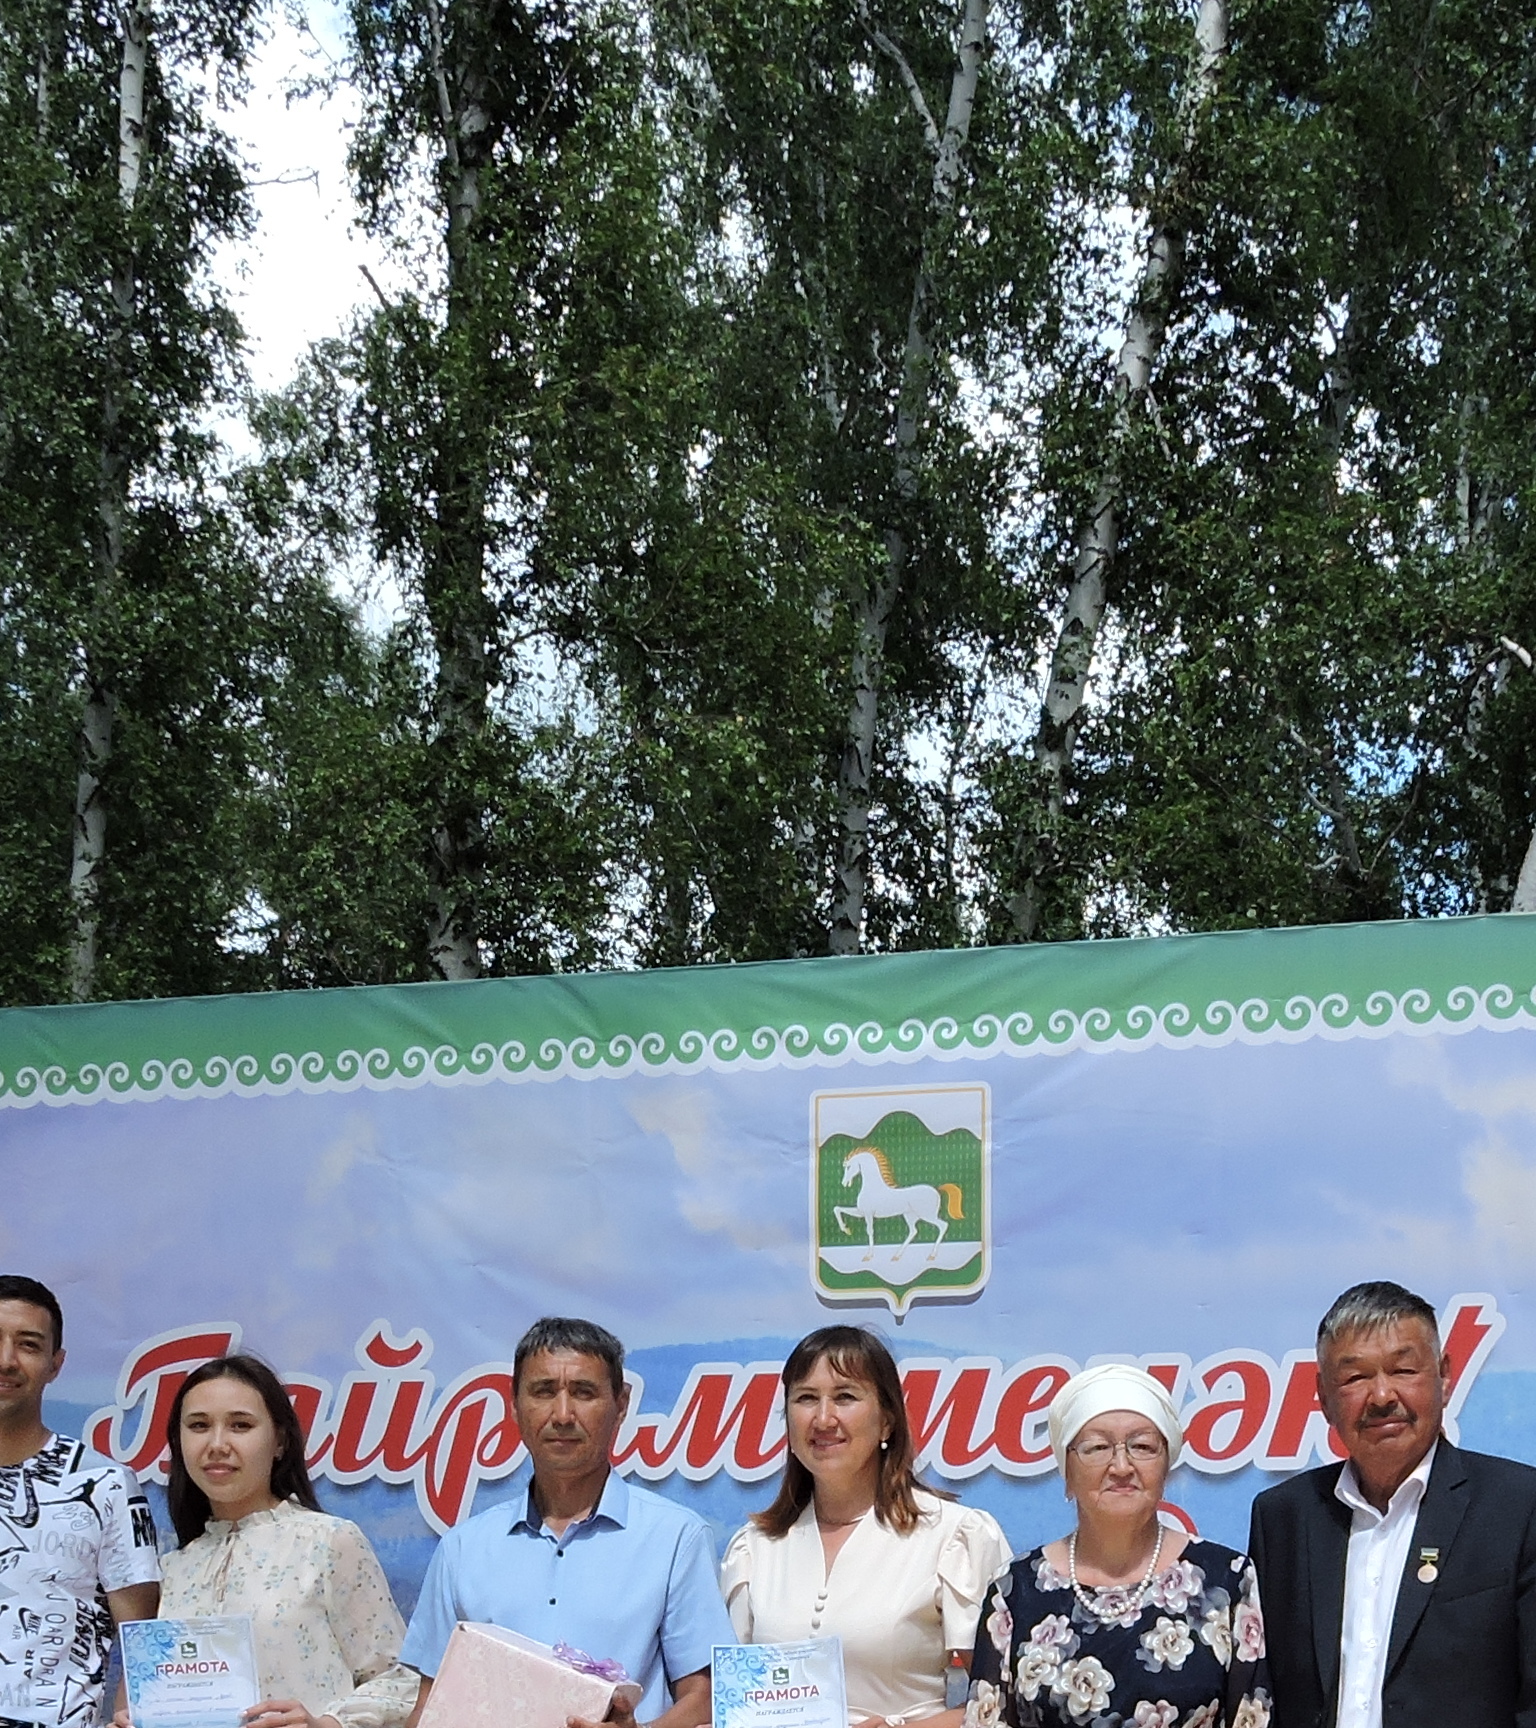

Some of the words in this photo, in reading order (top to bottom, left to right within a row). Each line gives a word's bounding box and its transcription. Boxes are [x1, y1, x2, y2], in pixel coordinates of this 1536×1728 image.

[24, 1649, 35, 1680] AIR
[155, 1661, 230, 1676] ГРАМОТА
[744, 1685, 820, 1702] ГРАМОТА
